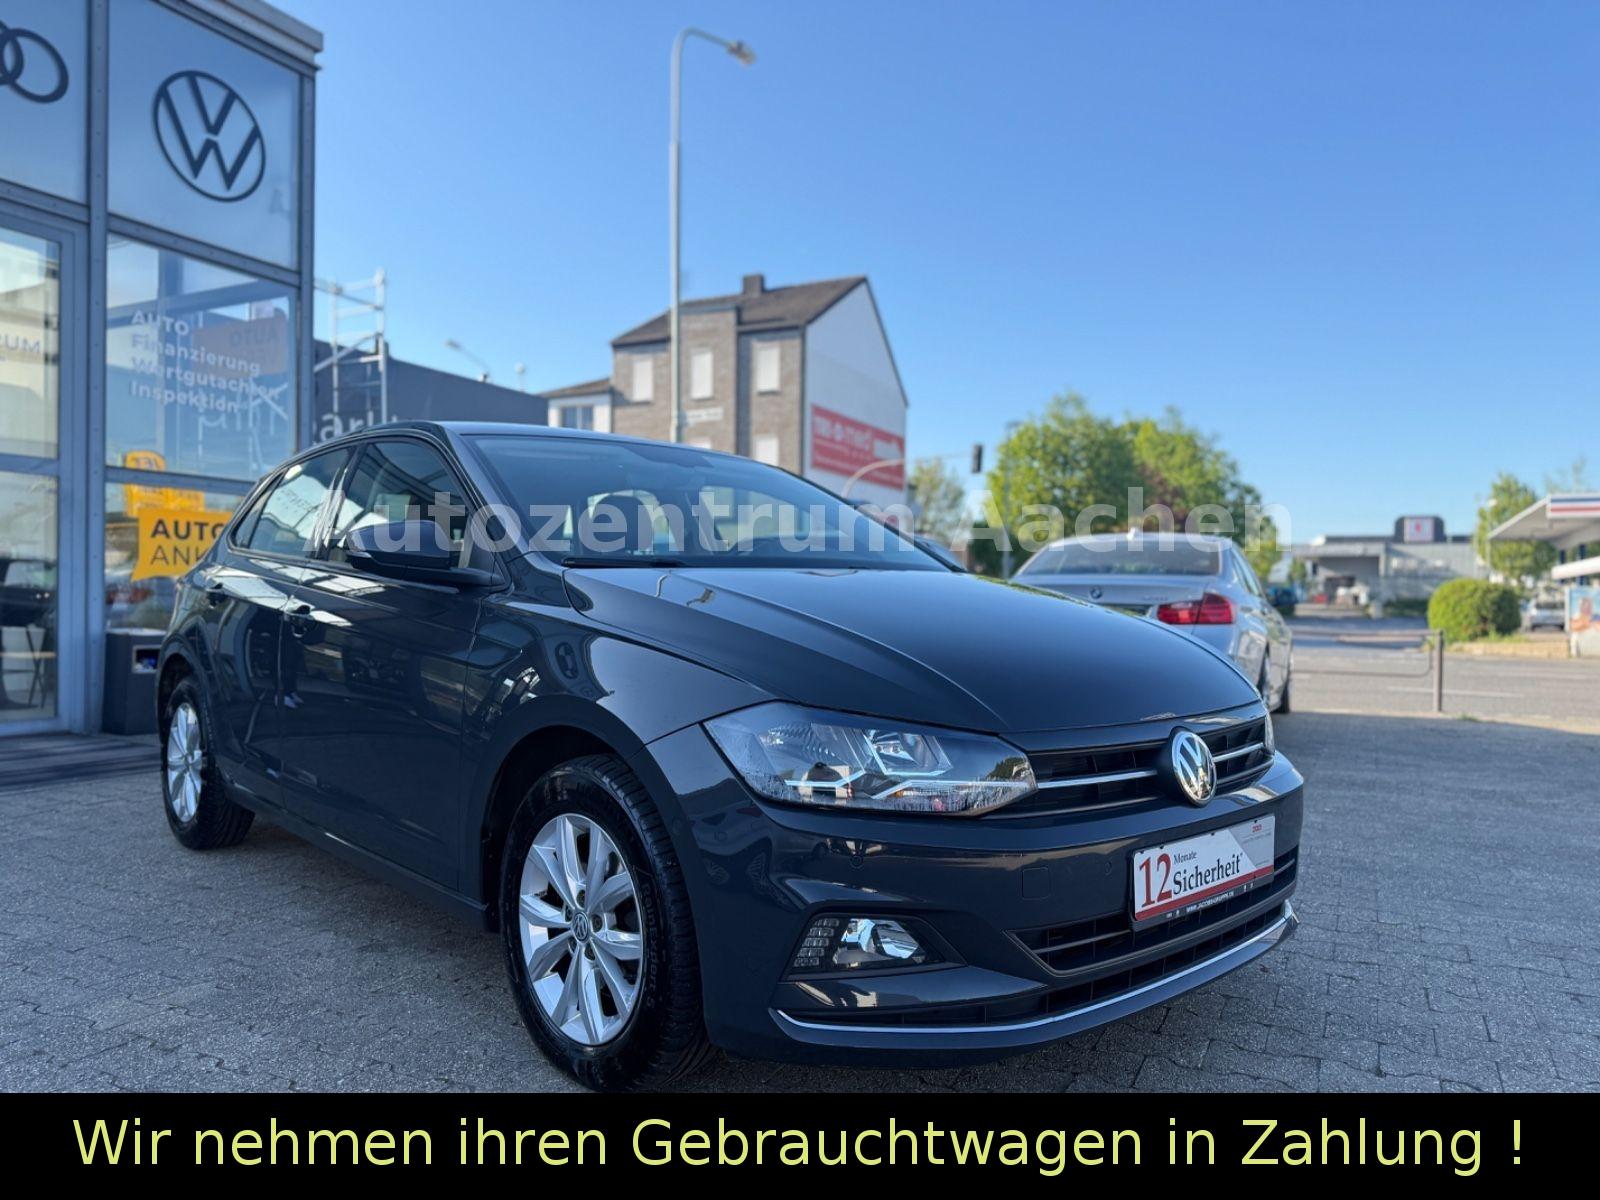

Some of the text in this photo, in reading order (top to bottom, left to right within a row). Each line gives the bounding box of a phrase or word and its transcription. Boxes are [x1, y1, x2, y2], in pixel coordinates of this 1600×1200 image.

[155, 73, 264, 199] VW
[131, 310, 189, 336] AUTO
[0, 332, 40, 352] UM
[131, 333, 261, 379] Finanzierung
[130, 379, 239, 414] Inspektion
[1174, 851, 1197, 865] Monate
[1139, 853, 1172, 907] 12
